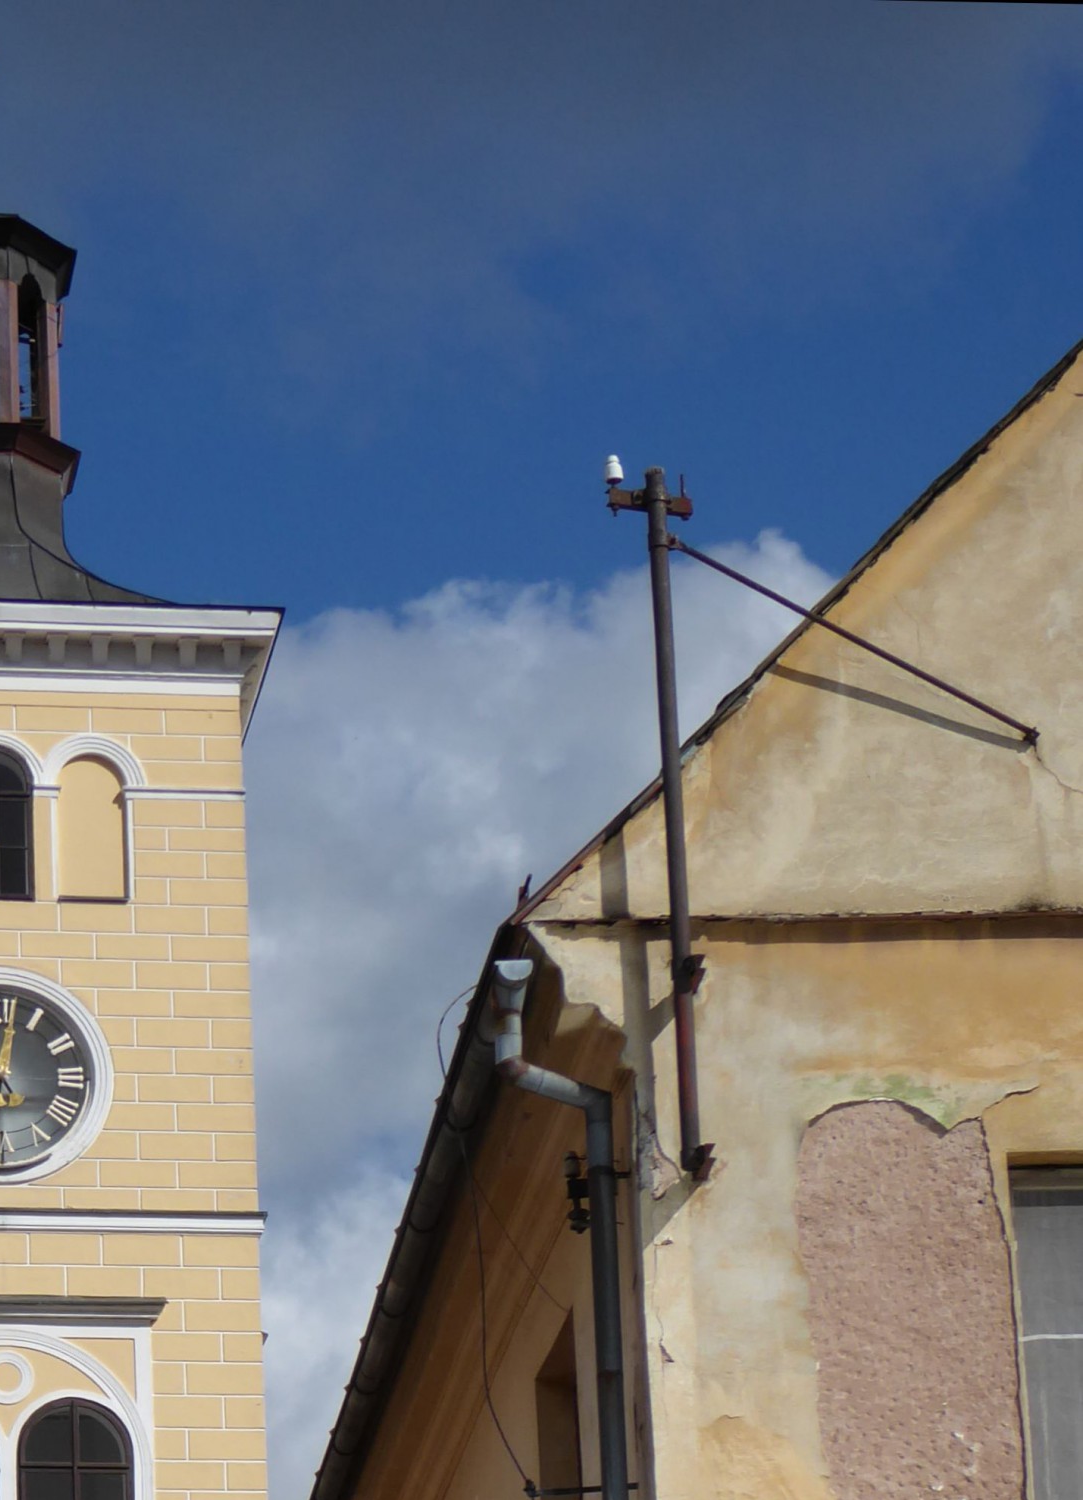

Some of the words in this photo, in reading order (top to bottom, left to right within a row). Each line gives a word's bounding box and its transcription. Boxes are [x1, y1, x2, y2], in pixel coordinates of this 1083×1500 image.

[26, 1008, 44, 1031] I
[47, 1033, 75, 1055] II
[57, 1066, 85, 1090] III
[46, 1095, 79, 1127] IIII
[31, 1122, 52, 1147] V
